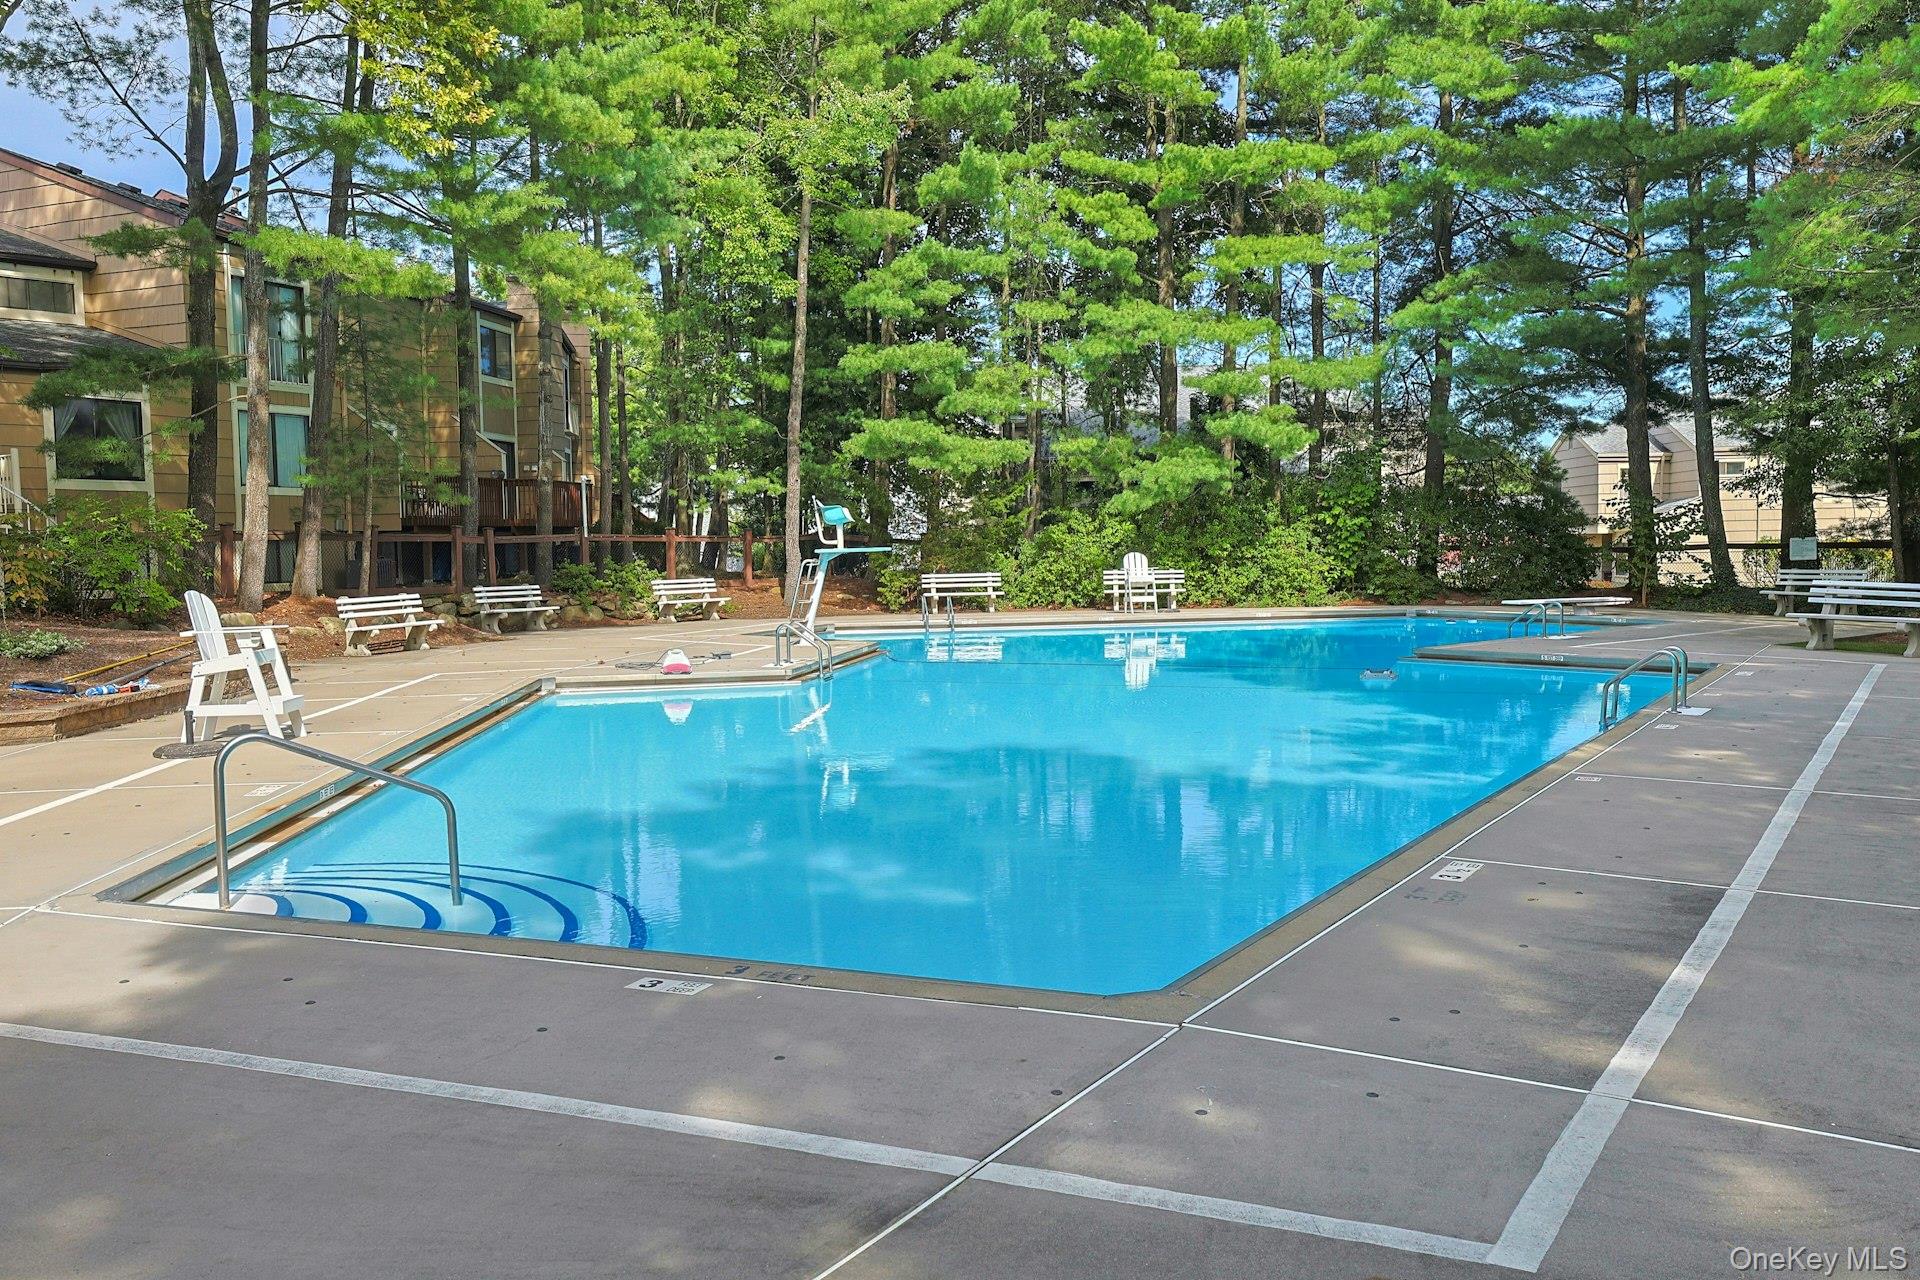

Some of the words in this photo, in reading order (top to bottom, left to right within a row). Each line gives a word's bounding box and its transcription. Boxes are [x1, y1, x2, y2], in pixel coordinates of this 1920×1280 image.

[725, 965, 751, 975] 3
[756, 970, 816, 982] FEET
[638, 979, 664, 989] 3
